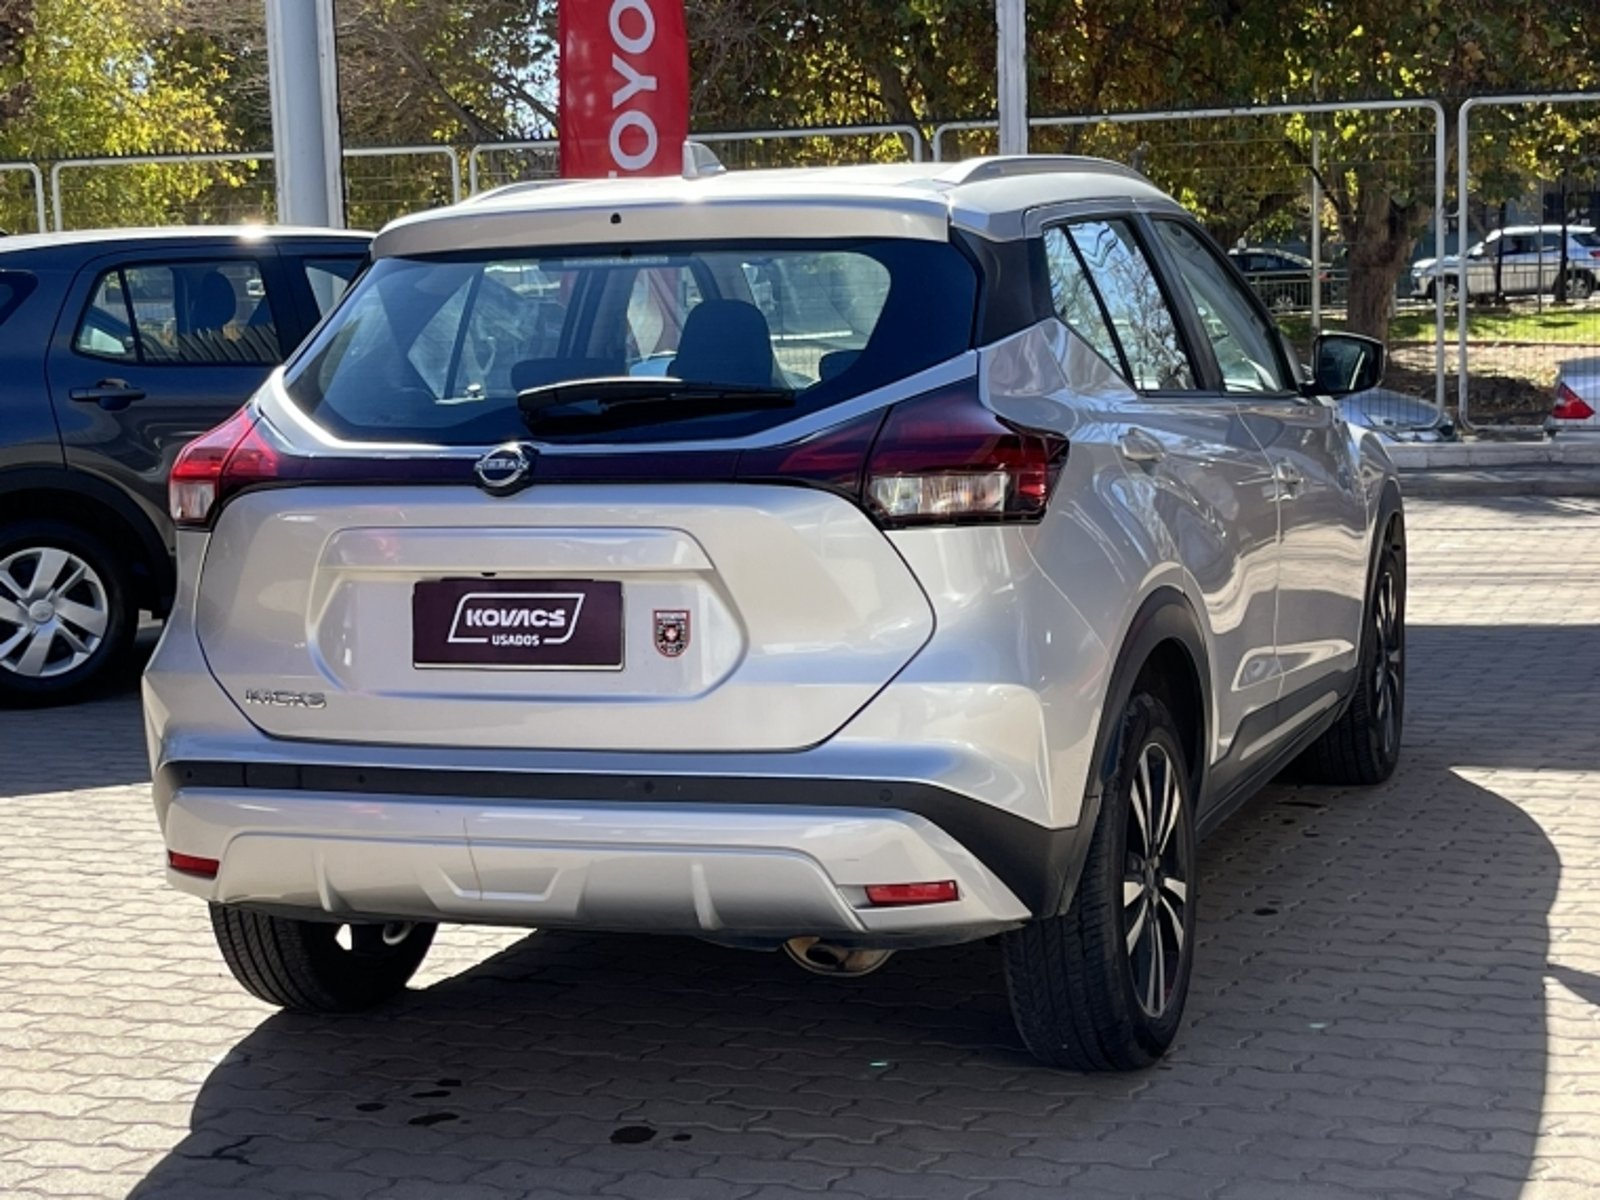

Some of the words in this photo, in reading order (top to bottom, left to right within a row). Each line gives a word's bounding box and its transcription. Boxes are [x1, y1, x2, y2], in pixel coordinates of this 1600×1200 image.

[609, 0, 657, 178] OYO
[465, 608, 566, 627] KOVACS
[491, 634, 540, 646] USADOS
[245, 688, 327, 709] KICKS
